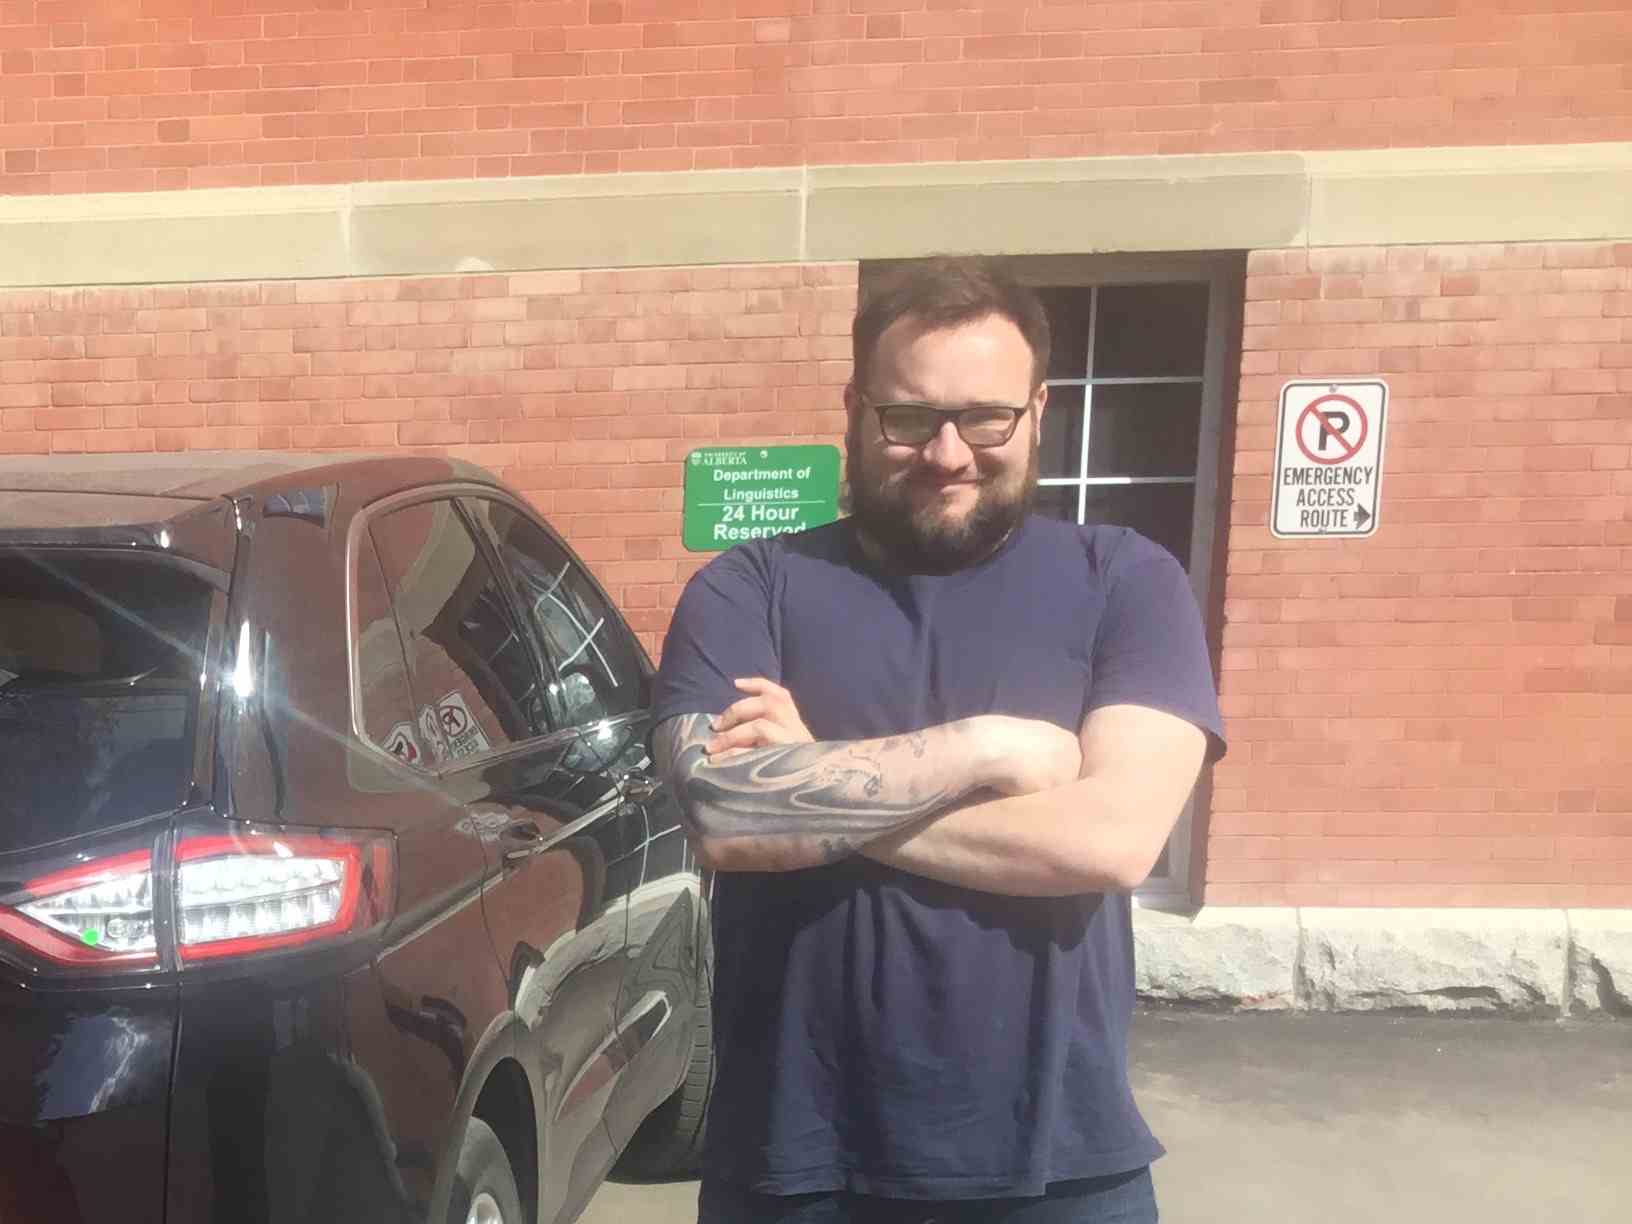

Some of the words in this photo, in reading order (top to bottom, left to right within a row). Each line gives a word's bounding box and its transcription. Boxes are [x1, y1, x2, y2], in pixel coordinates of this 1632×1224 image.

[713, 468, 792, 484] Department
[796, 466, 812, 480] of
[1283, 466, 1374, 486] EMERGENCY
[723, 487, 799, 503] Linguistics
[1296, 487, 1356, 508] ACCESS
[721, 504, 745, 522] 24
[751, 503, 800, 521] Hour
[1300, 508, 1349, 528] ROUTE
